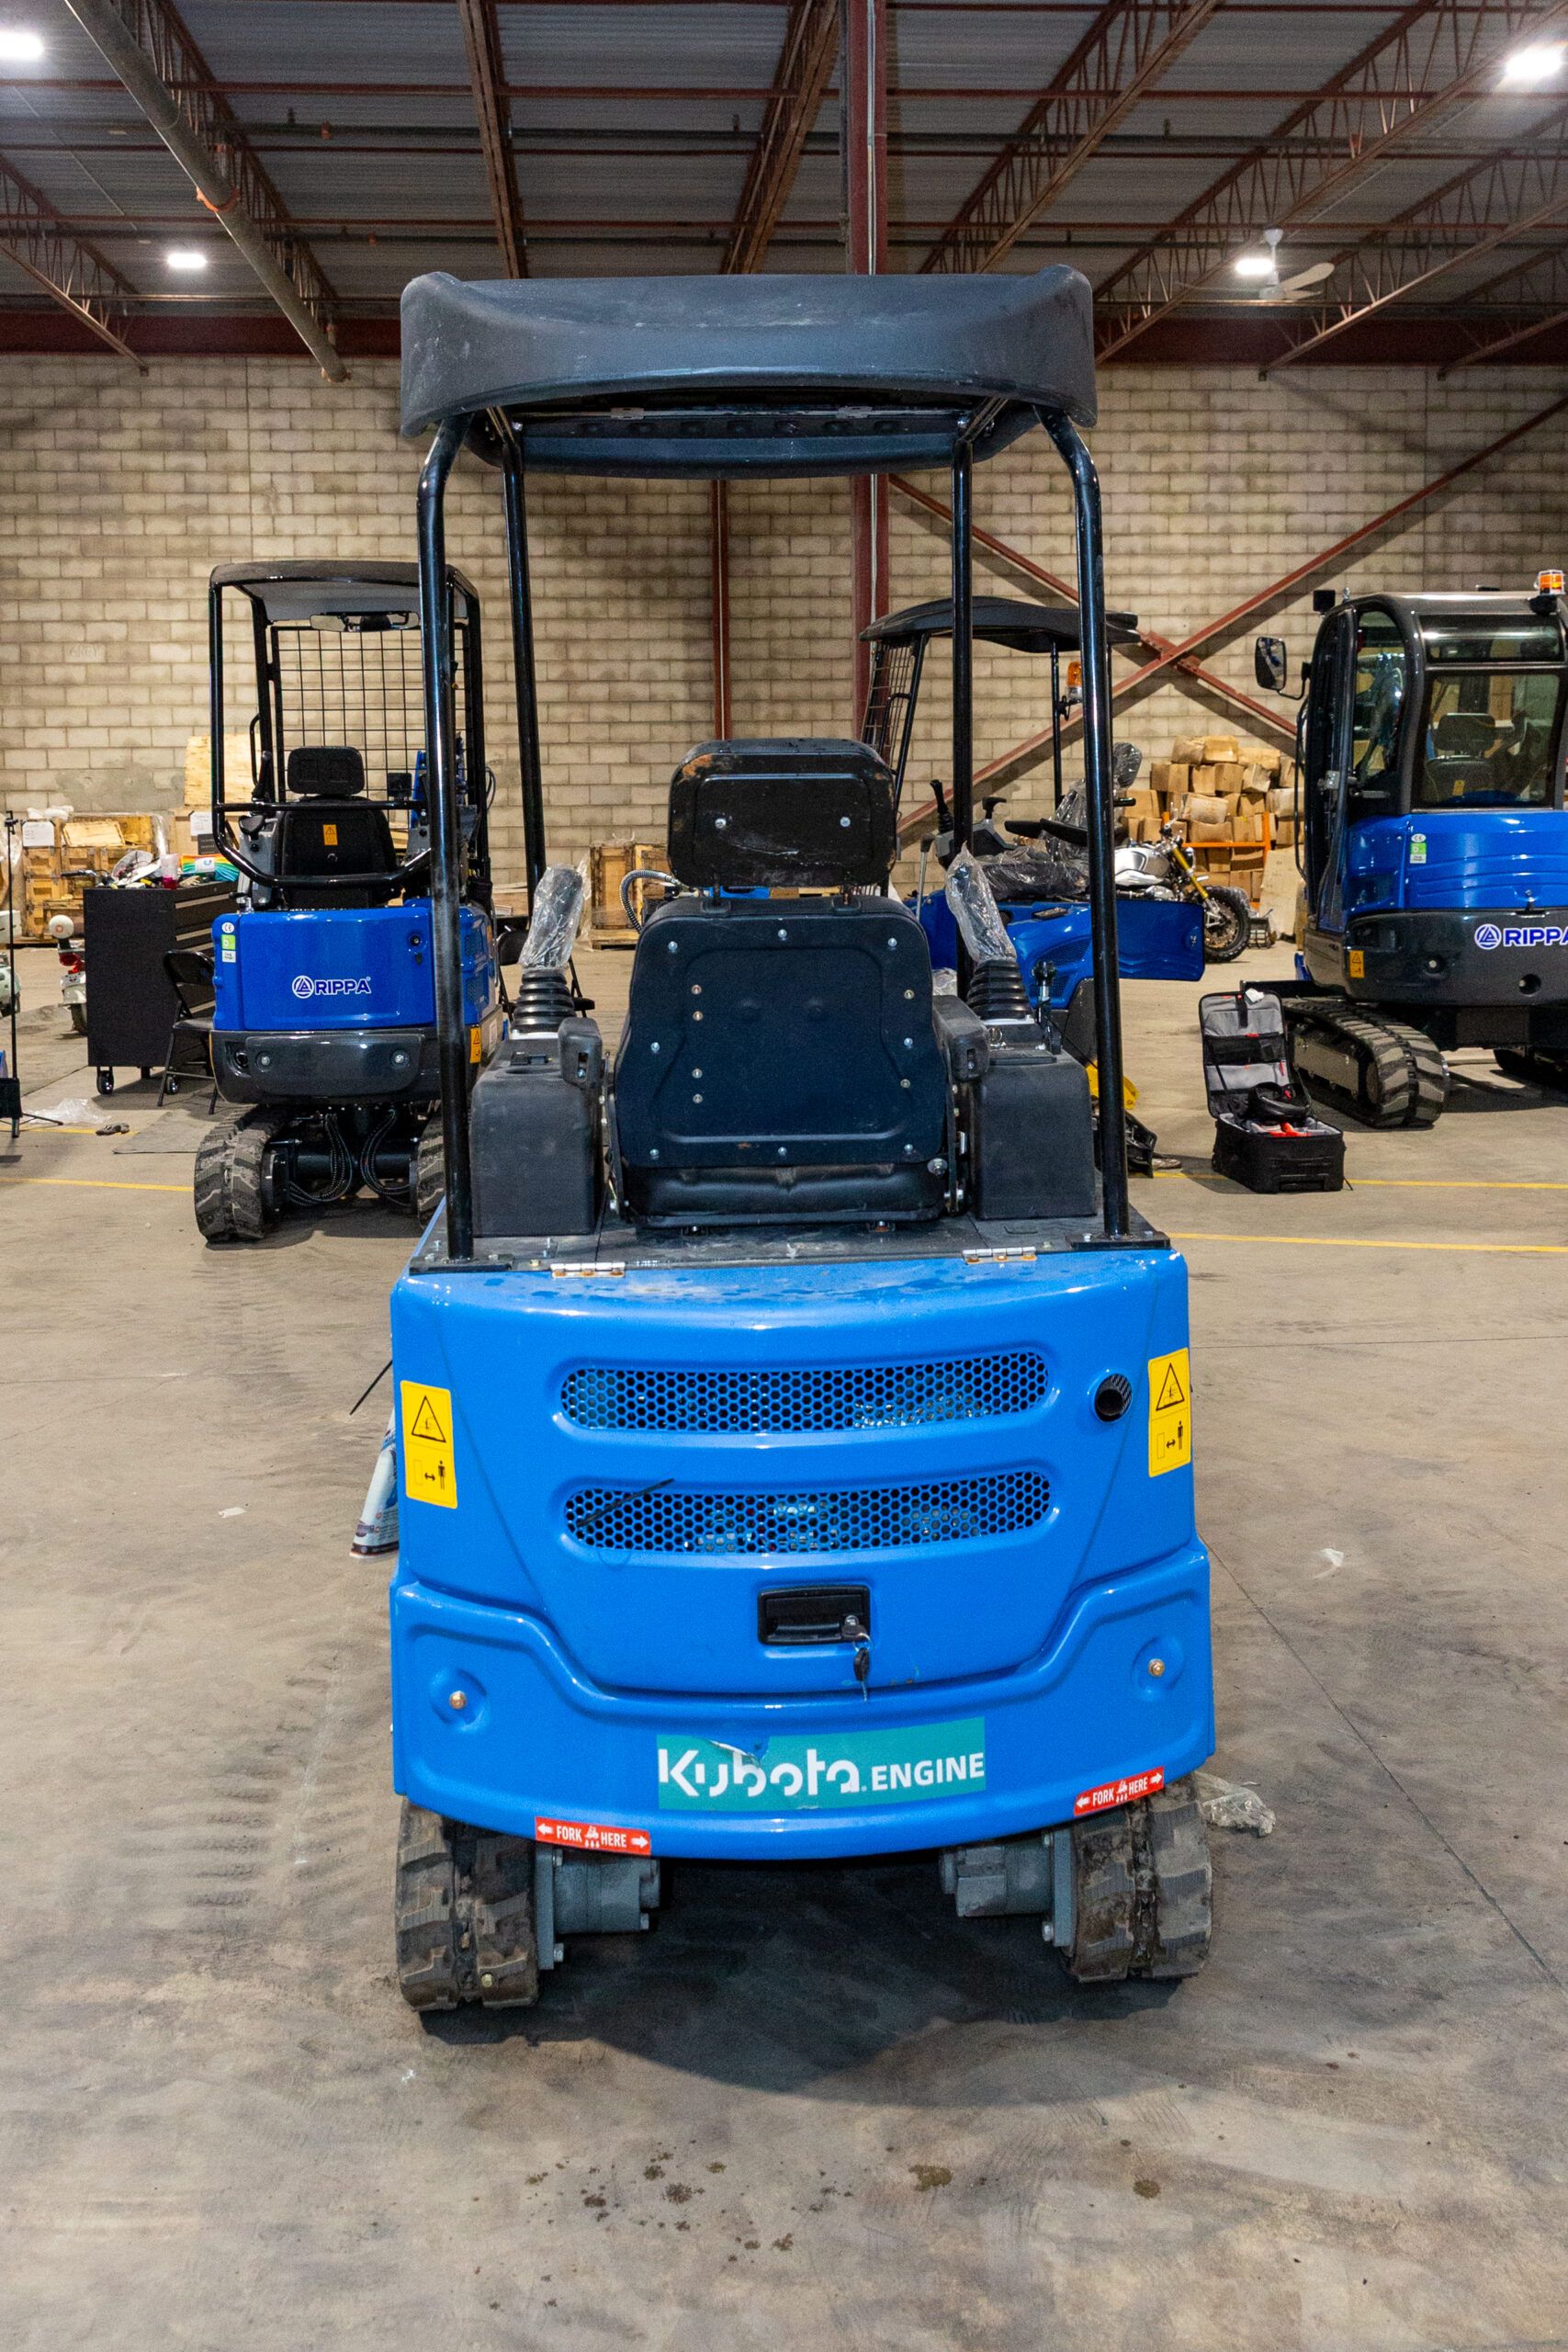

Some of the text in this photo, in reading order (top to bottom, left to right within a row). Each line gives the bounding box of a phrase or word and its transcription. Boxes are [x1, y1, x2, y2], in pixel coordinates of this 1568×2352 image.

[314, 978, 371, 995] RIPPA
[658, 1747, 986, 1797] Kubota ENGINE
[1092, 1777, 1148, 1806] FORK HERE
[556, 1825, 626, 1848] FORK HERE
